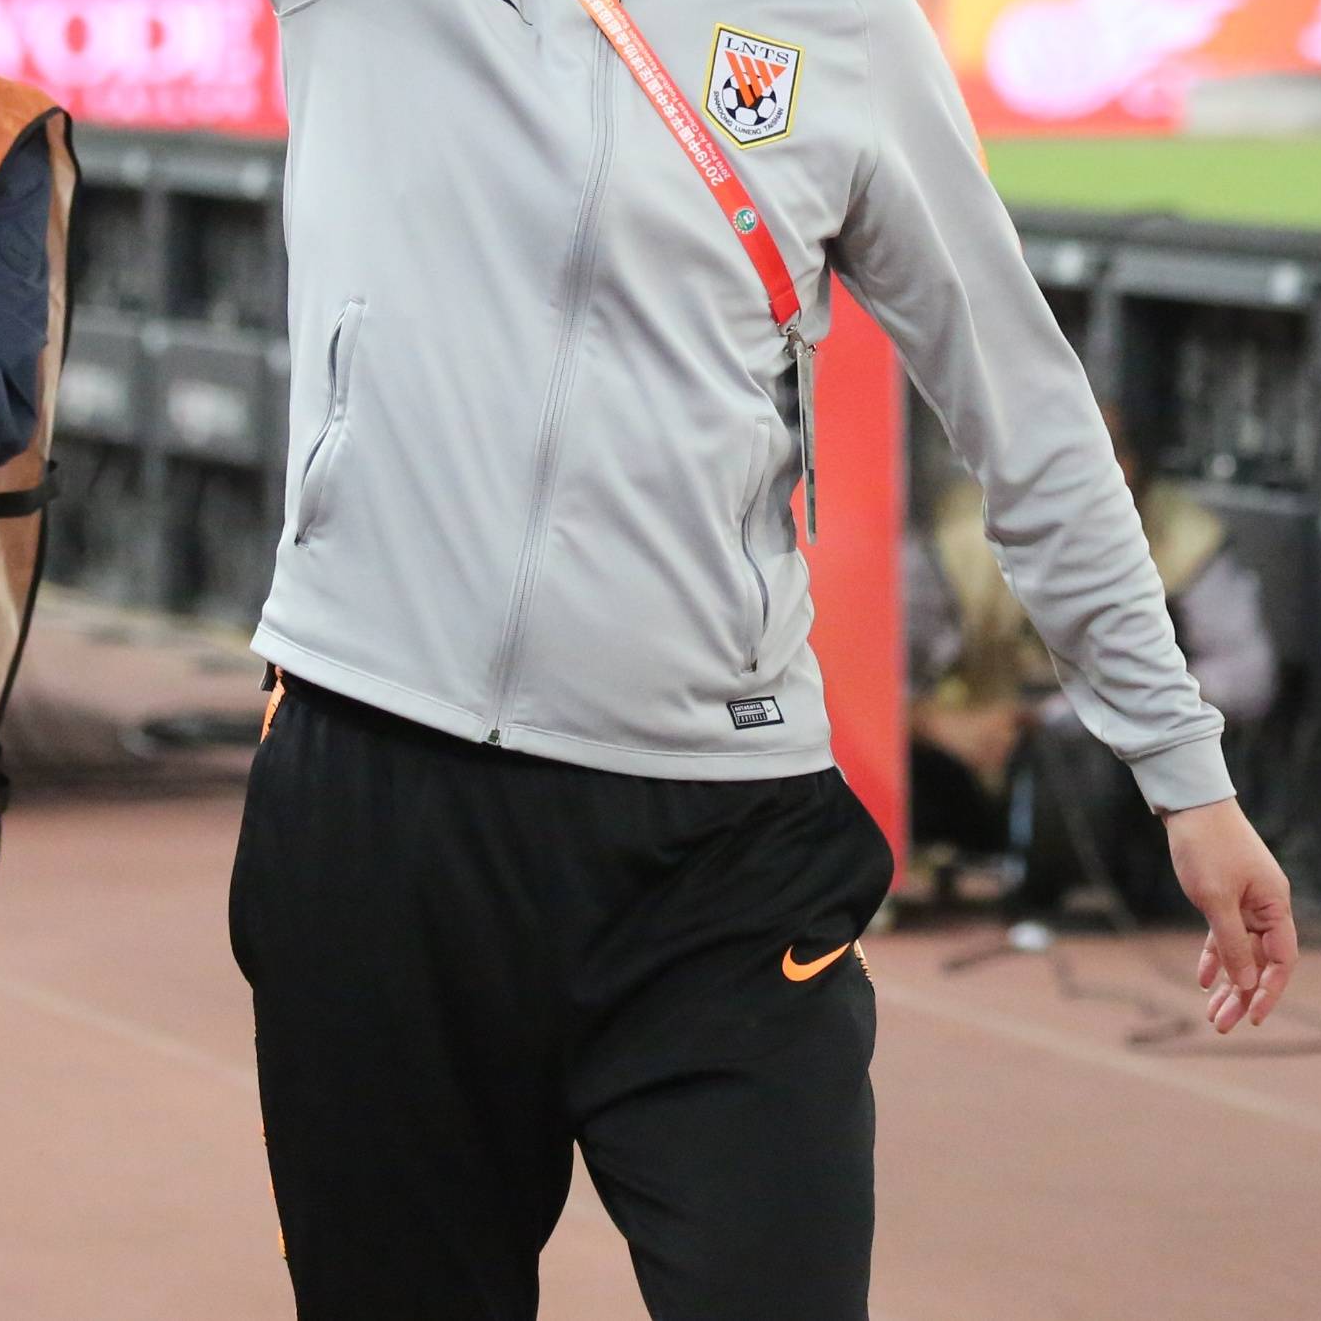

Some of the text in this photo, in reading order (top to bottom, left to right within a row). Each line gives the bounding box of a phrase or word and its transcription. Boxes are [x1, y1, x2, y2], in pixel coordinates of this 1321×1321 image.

[627, 27, 659, 72] Association
[725, 37, 789, 65] LNTS
[655, 71, 678, 102] Football
[677, 102, 700, 133] Chinese
[713, 90, 784, 136] SHANDONG LUNENG TAISHAN
[716, 160, 731, 180] 2019
